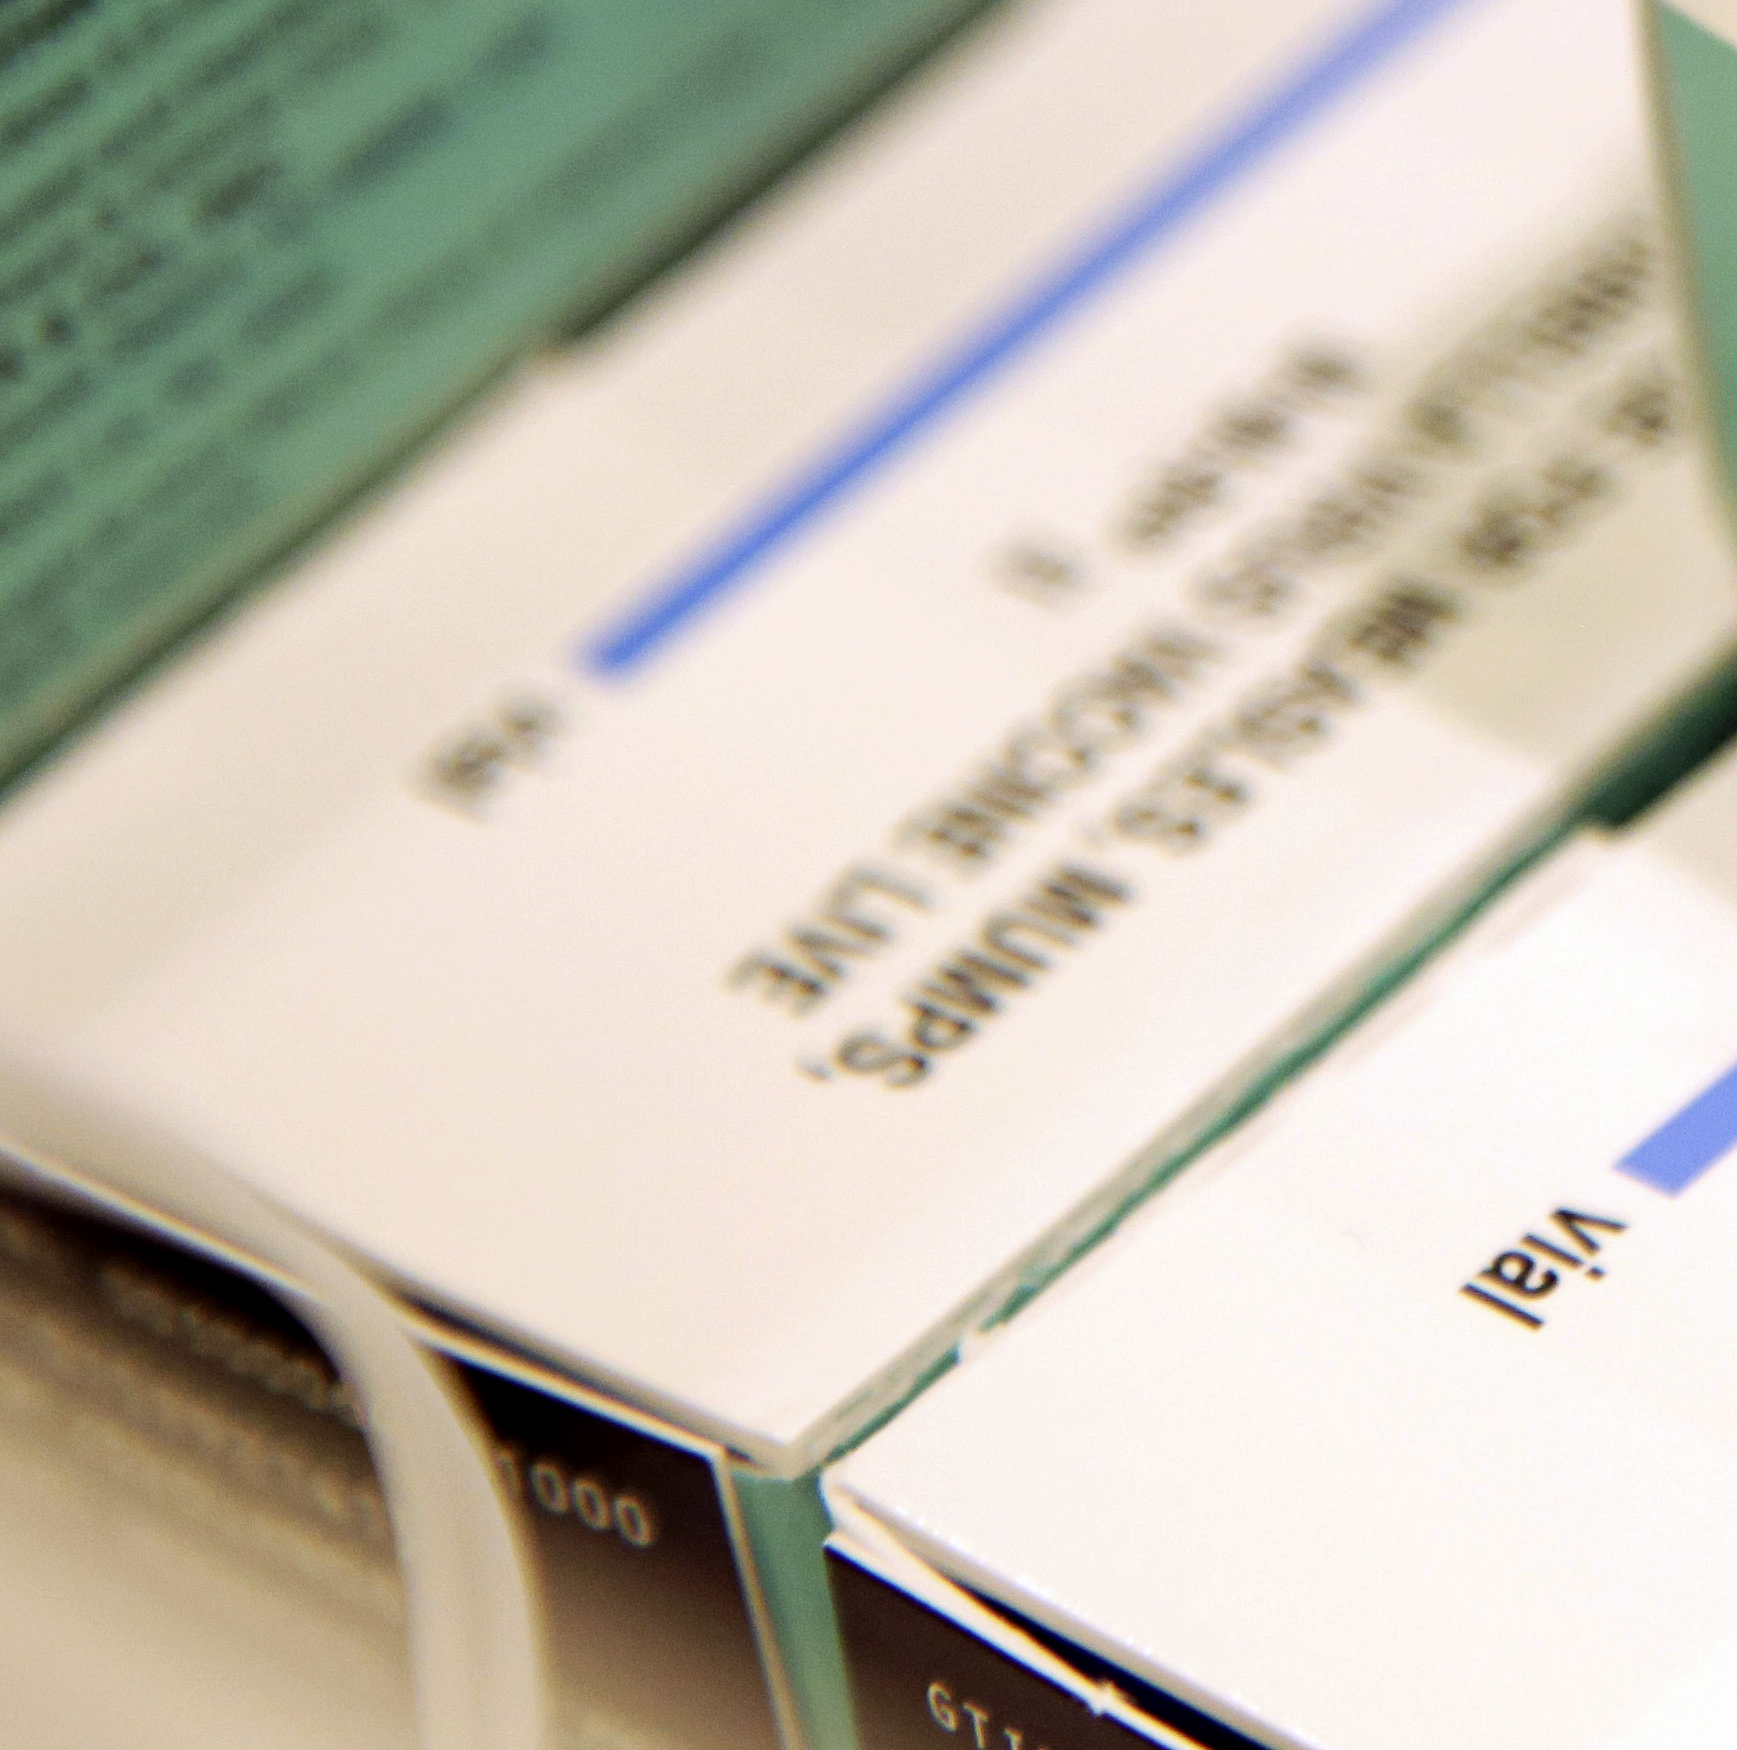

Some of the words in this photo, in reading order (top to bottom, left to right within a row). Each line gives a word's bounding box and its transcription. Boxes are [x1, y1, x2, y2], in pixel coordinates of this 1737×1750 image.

[722, 850, 935, 1028] LIVE
[800, 860, 1137, 1096] MUMPS,
[1457, 1203, 1630, 1331] vial
